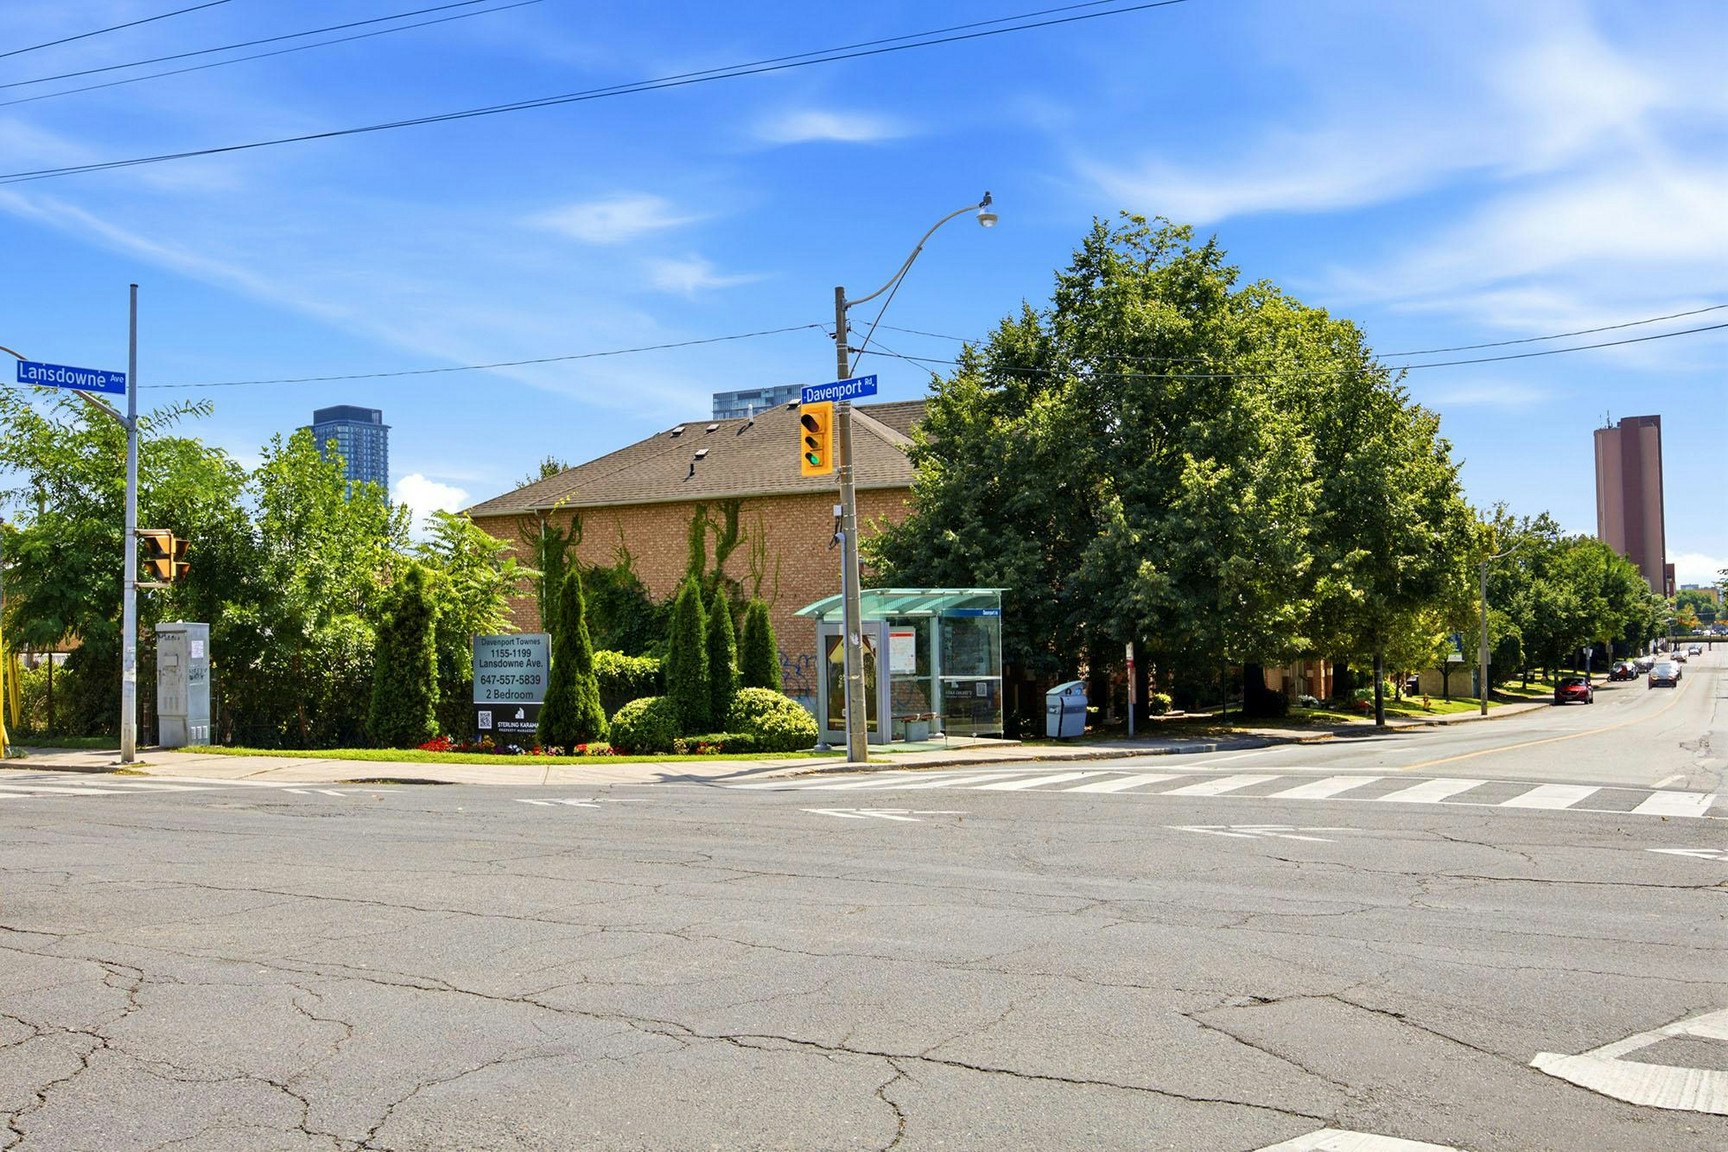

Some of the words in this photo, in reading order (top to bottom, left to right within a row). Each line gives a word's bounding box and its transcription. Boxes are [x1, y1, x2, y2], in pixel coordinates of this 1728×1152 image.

[20, 362, 106, 387] Lansdowne
[110, 374, 124, 384] Ave
[807, 379, 862, 402] Davenport
[481, 639, 515, 647] Davenport
[516, 637, 540, 645] Townes
[491, 649, 532, 658] 1155-1199
[479, 659, 524, 668] Lansdowne
[526, 659, 543, 668] Ave.
[480, 675, 541, 685] 647-557-5839
[486, 689, 492, 699] 2
[494, 689, 534, 699] Bedroom
